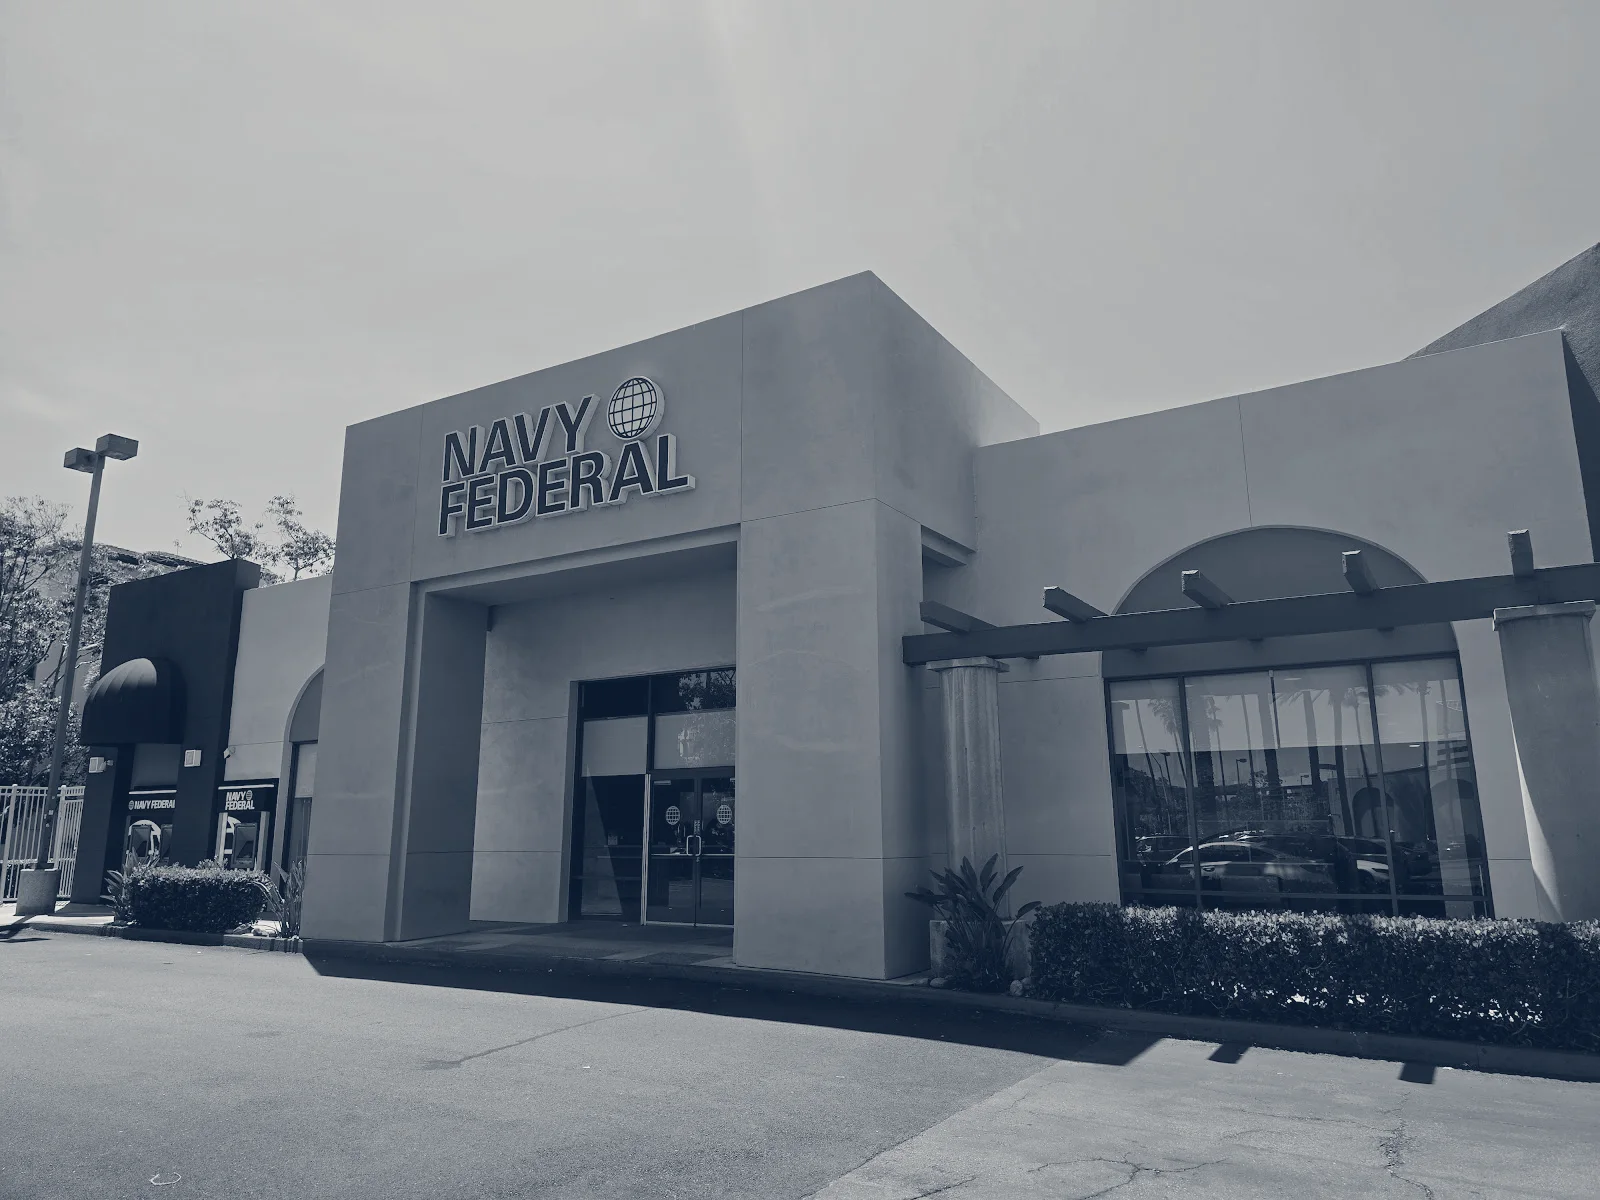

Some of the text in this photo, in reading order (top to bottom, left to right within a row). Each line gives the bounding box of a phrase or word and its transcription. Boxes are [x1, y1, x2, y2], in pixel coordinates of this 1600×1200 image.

[441, 394, 600, 483] NAVY
[438, 433, 695, 538] FEDERAL
[226, 791, 247, 802] NAVY
[134, 800, 151, 810] NAVY
[225, 800, 255, 811] FEDERAL
